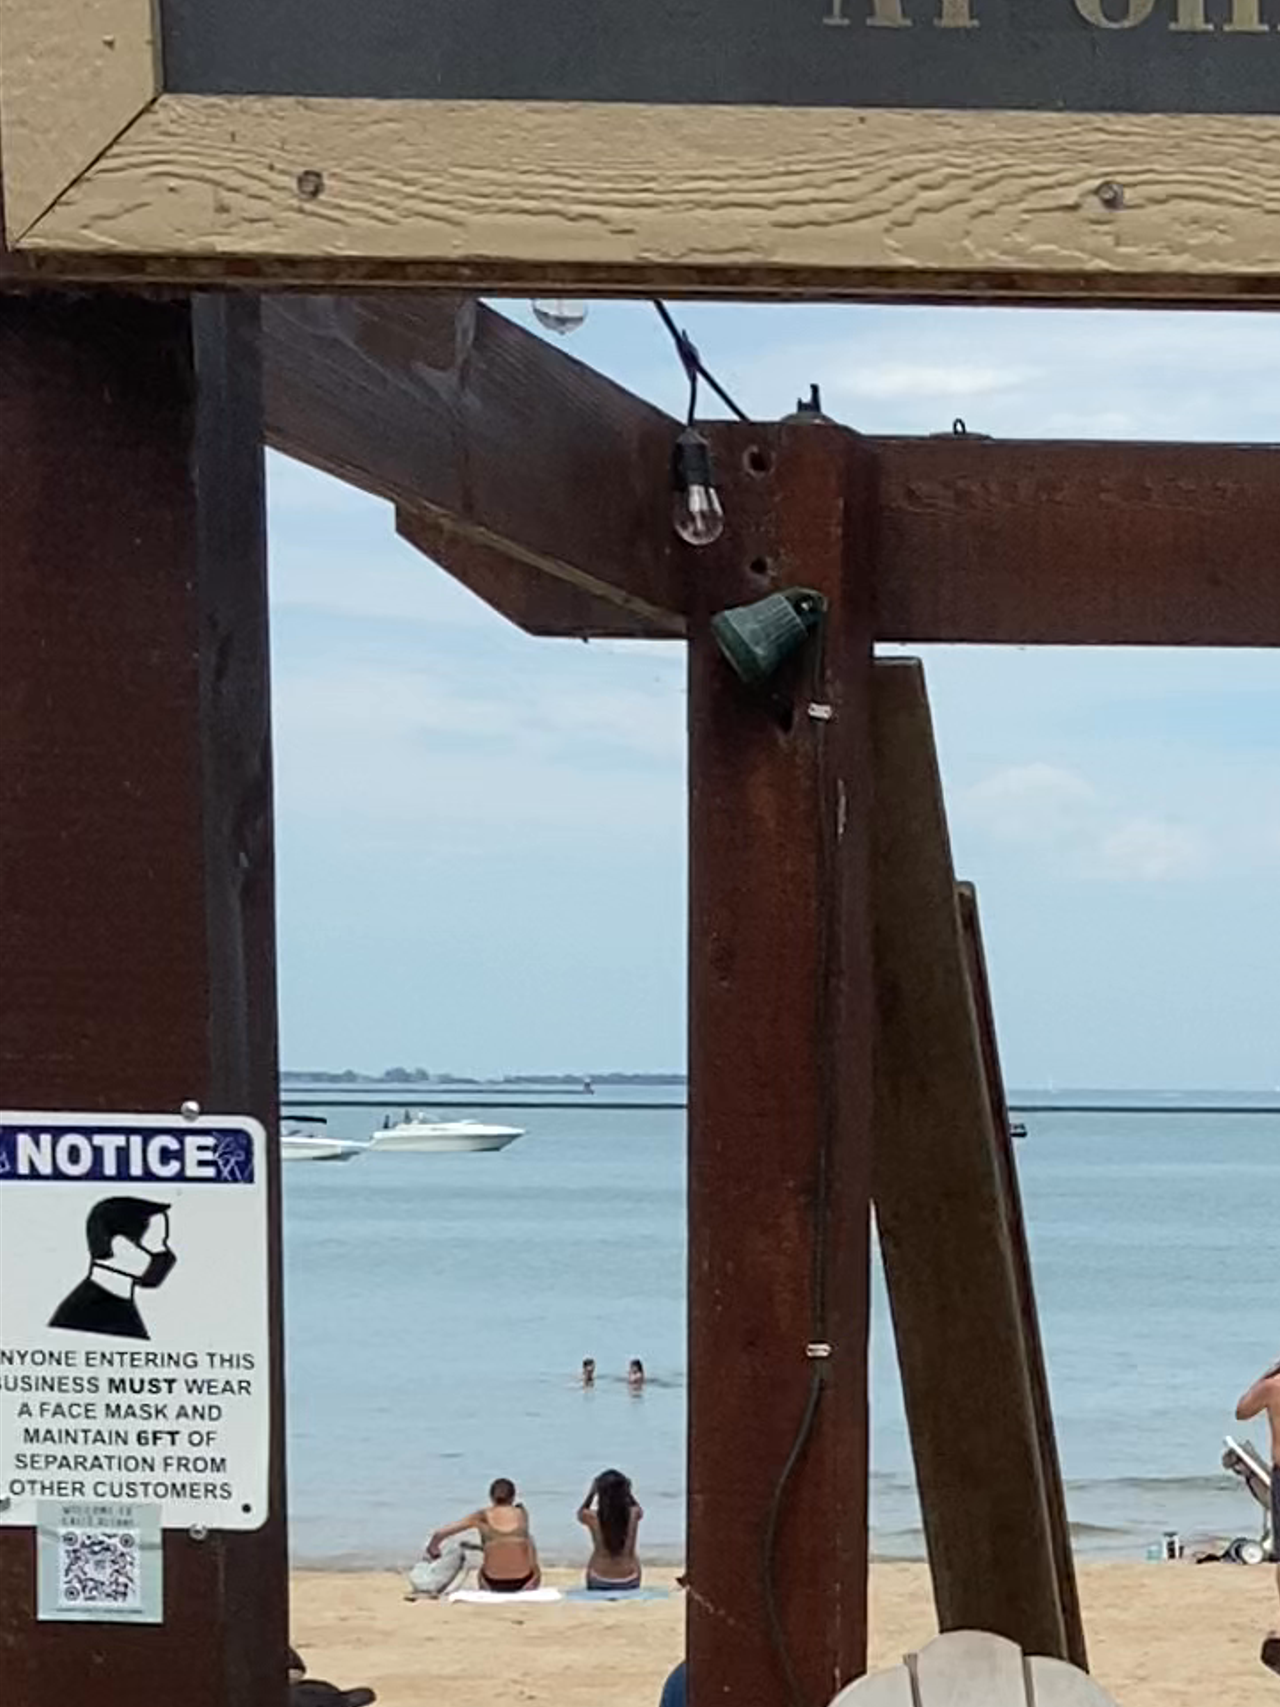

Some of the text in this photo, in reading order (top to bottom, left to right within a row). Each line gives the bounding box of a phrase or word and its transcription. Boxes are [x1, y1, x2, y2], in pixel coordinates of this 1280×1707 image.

[16, 1133, 216, 1179] NOTICE
[0, 1349, 256, 1370] NYONE ENTERING THIS
[0, 1374, 253, 1396] USINESS MUST WEAR
[17, 1402, 223, 1422] A FACE MASK AND
[23, 1427, 218, 1447] MAINTAIN 6FT OF
[14, 1453, 227, 1474] SEPARATION FROM
[9, 1479, 232, 1500] OTHER CUSTOMERS
